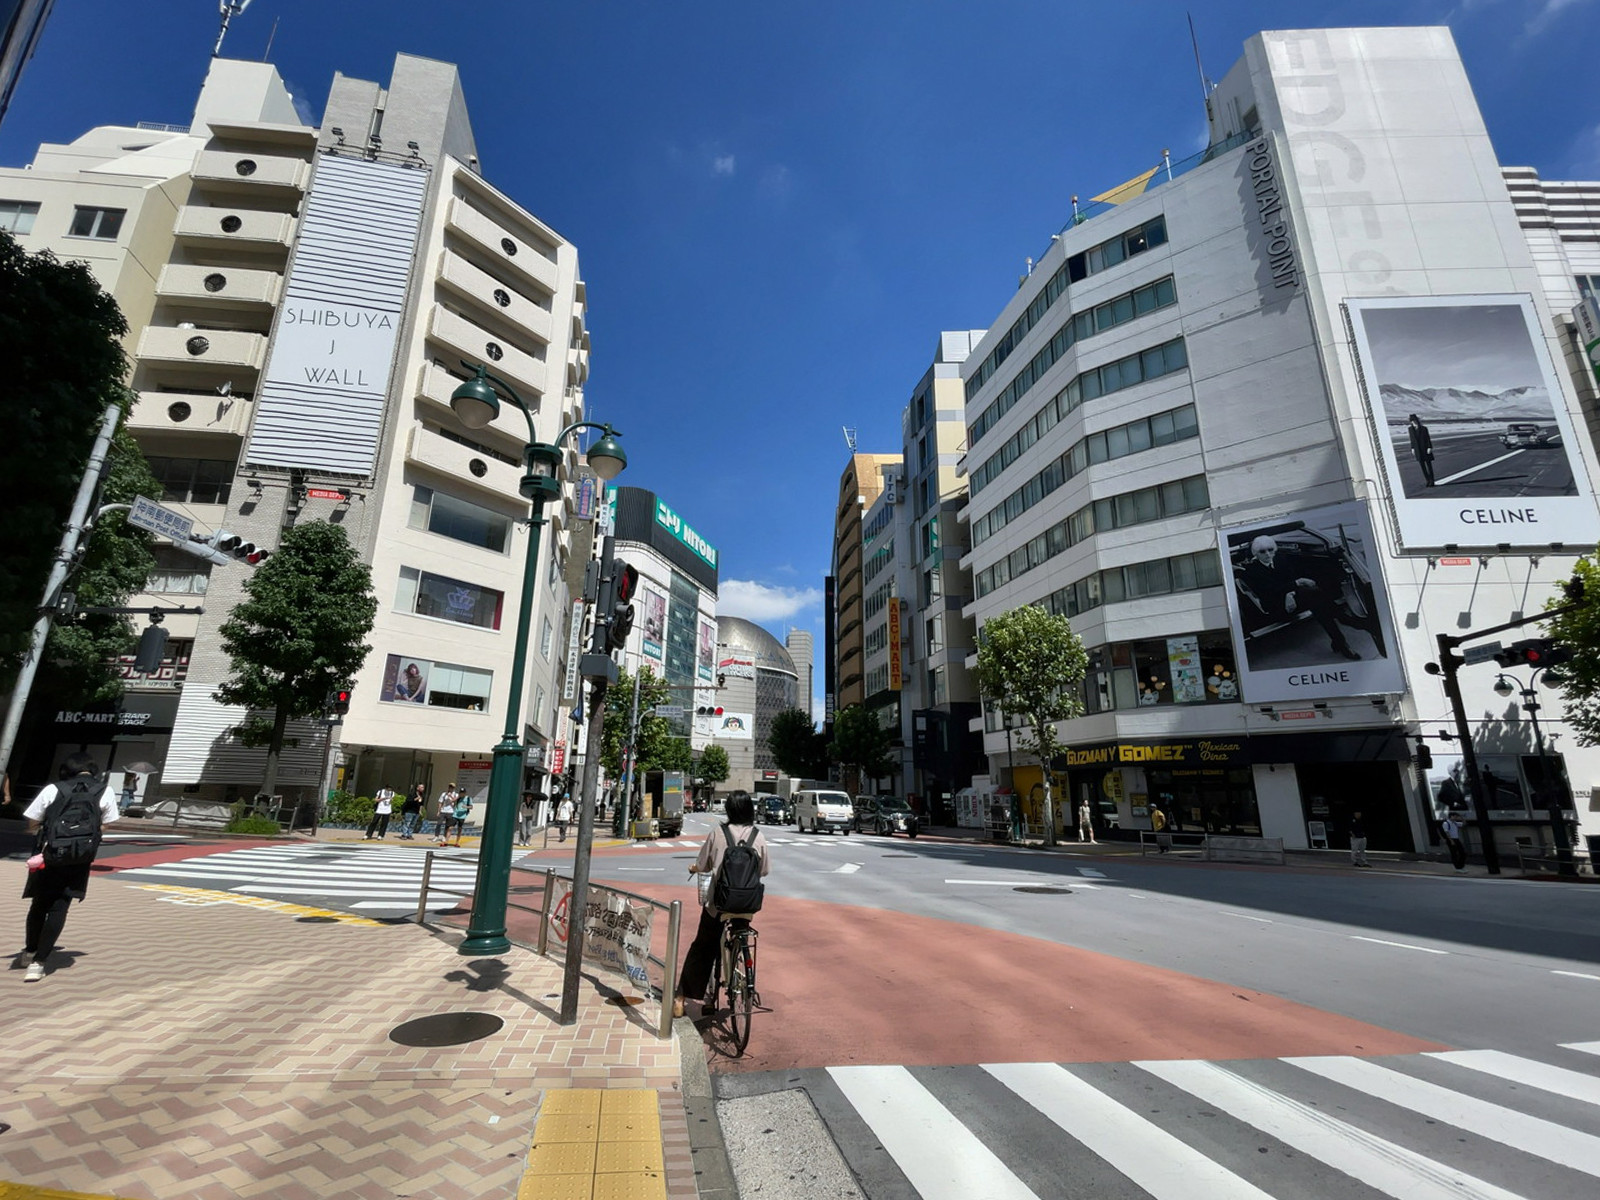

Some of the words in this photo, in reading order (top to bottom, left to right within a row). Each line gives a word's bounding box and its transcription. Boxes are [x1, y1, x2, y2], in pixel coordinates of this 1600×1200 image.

[1247, 138, 1283, 225] PORTAL
[1263, 221, 1300, 289] POINT
[284, 307, 392, 330] SHIBUYA
[328, 339, 335, 355] J
[304, 366, 369, 387] WALL
[886, 473, 895, 502] ITC
[658, 502, 681, 535] ニトリ
[1459, 507, 1538, 524] CELINE
[155, 523, 169, 534] Post
[170, 528, 187, 541] Office
[683, 523, 716, 566] NITORI
[890, 602, 900, 685] ABC-MART
[1288, 669, 1351, 687] CELINE
[55, 711, 115, 723] ABC-MART
[118, 712, 151, 720] GRAND
[1118, 744, 1185, 762] GOMEZ
[1198, 741, 1241, 752] Mexican
[1200, 751, 1229, 761] Diner
